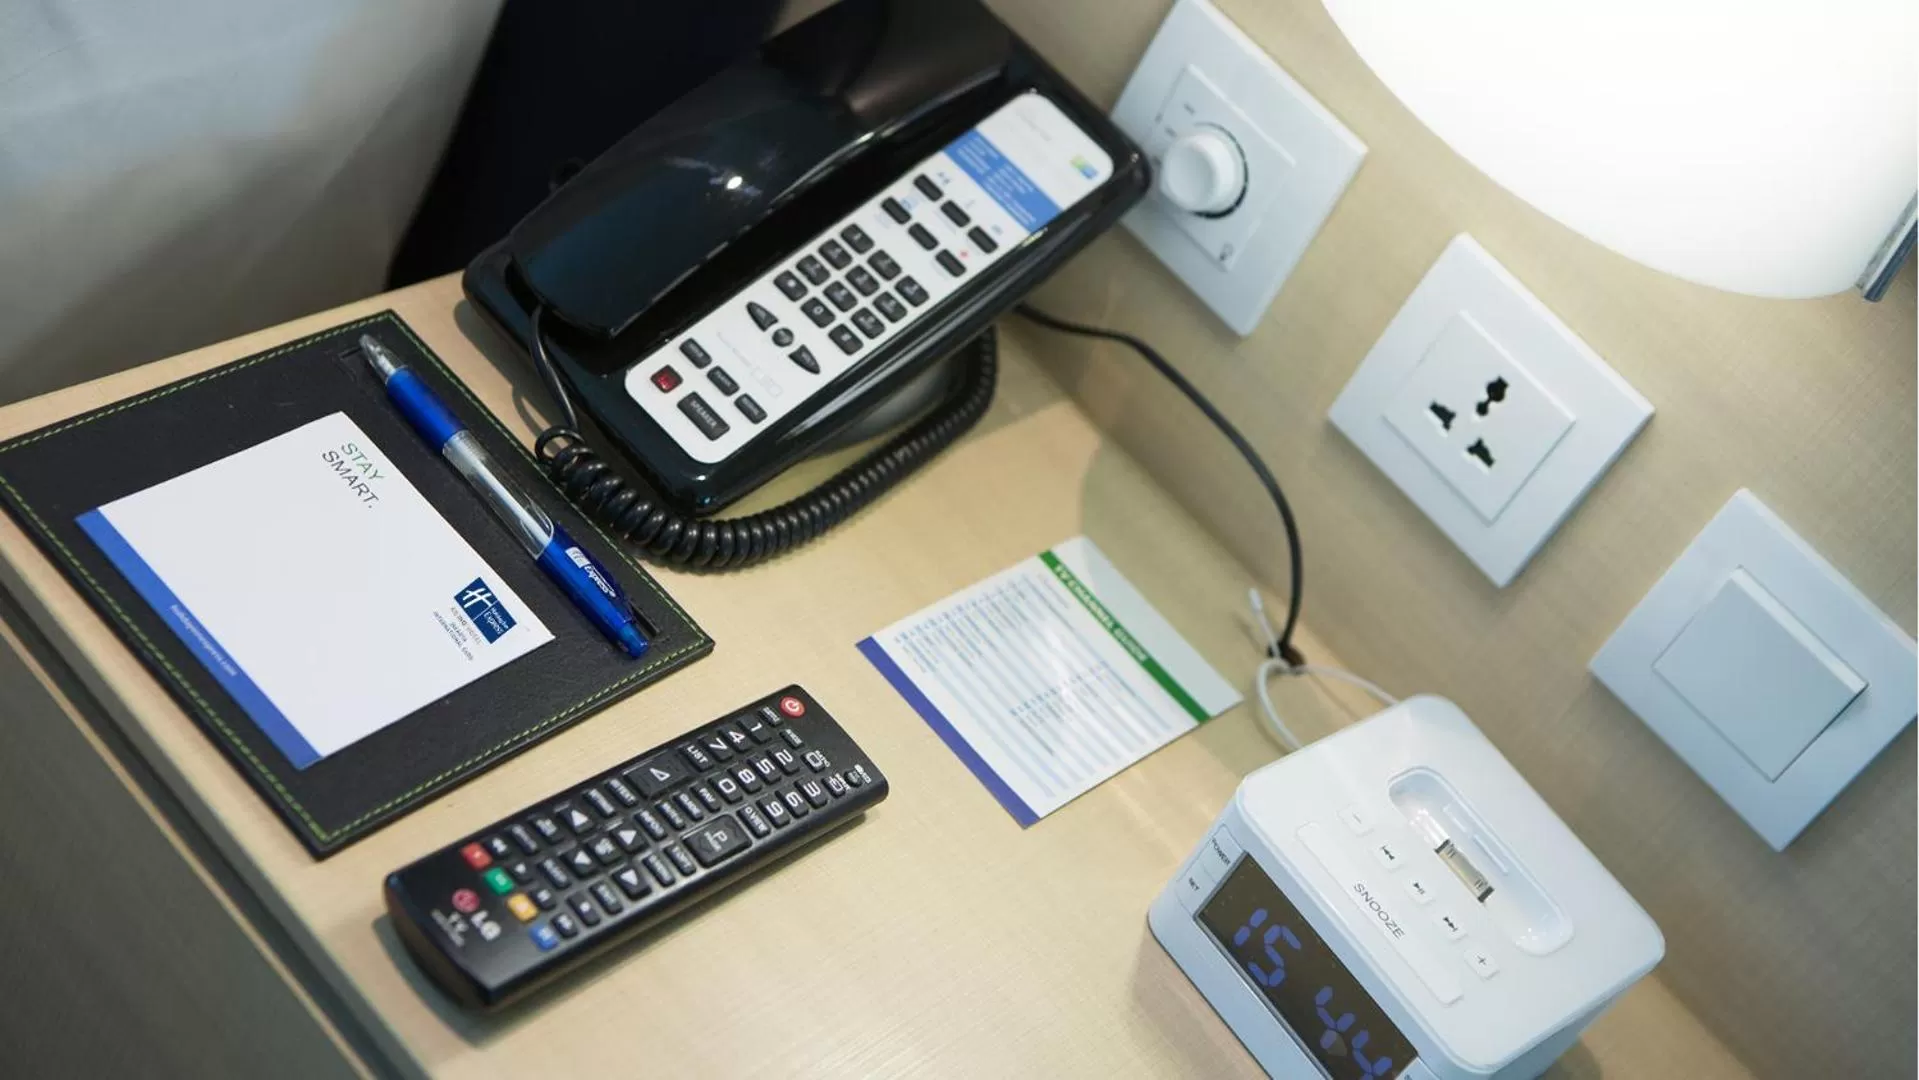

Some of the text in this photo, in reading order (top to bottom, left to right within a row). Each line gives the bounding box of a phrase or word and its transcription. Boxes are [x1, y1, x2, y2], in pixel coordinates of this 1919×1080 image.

[341, 442, 386, 479] STAY
[322, 450, 379, 508] SMART.
[751, 722, 763, 732] 1
[709, 737, 728, 751] 7
[729, 730, 746, 744] 4
[686, 745, 709, 764] LIST
[775, 749, 793, 766] 2
[756, 758, 776, 775] 5
[738, 768, 756, 784] 8
[718, 778, 738, 794] 0
[803, 780, 821, 797] 3
[785, 790, 804, 808] 6
[766, 800, 784, 818] 9
[1353, 882, 1405, 940] SNOOZE
[1232, 908, 1303, 988] 15
